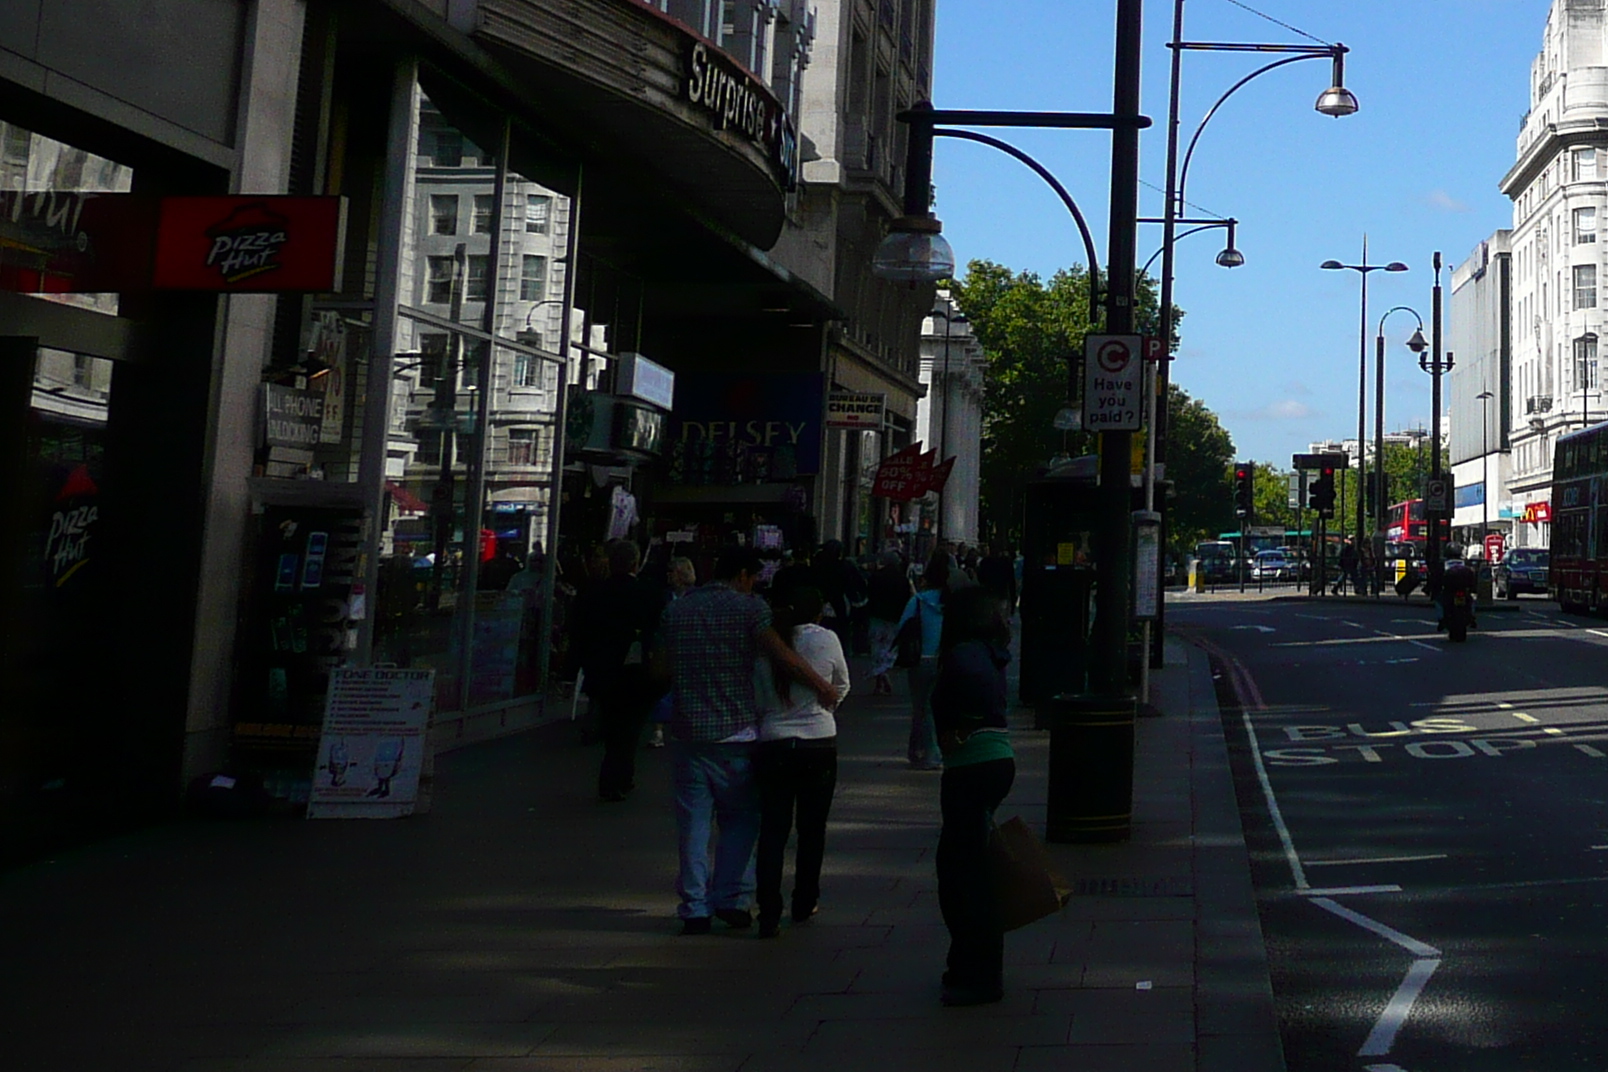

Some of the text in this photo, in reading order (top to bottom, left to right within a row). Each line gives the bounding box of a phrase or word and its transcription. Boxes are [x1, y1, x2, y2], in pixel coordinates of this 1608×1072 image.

[688, 41, 766, 144] Surprise
[207, 230, 287, 266] Pizza
[220, 247, 278, 274] Hut
[1094, 377, 1132, 391] Have
[284, 394, 323, 418] PHONE
[828, 403, 882, 414] CHANGE
[1098, 396, 1126, 409] you
[881, 479, 906, 492] OFF
[44, 502, 100, 561] Pizza
[53, 530, 93, 575] Hut
[1283, 718, 1477, 741] BUS
[1263, 738, 1538, 766] STOP
